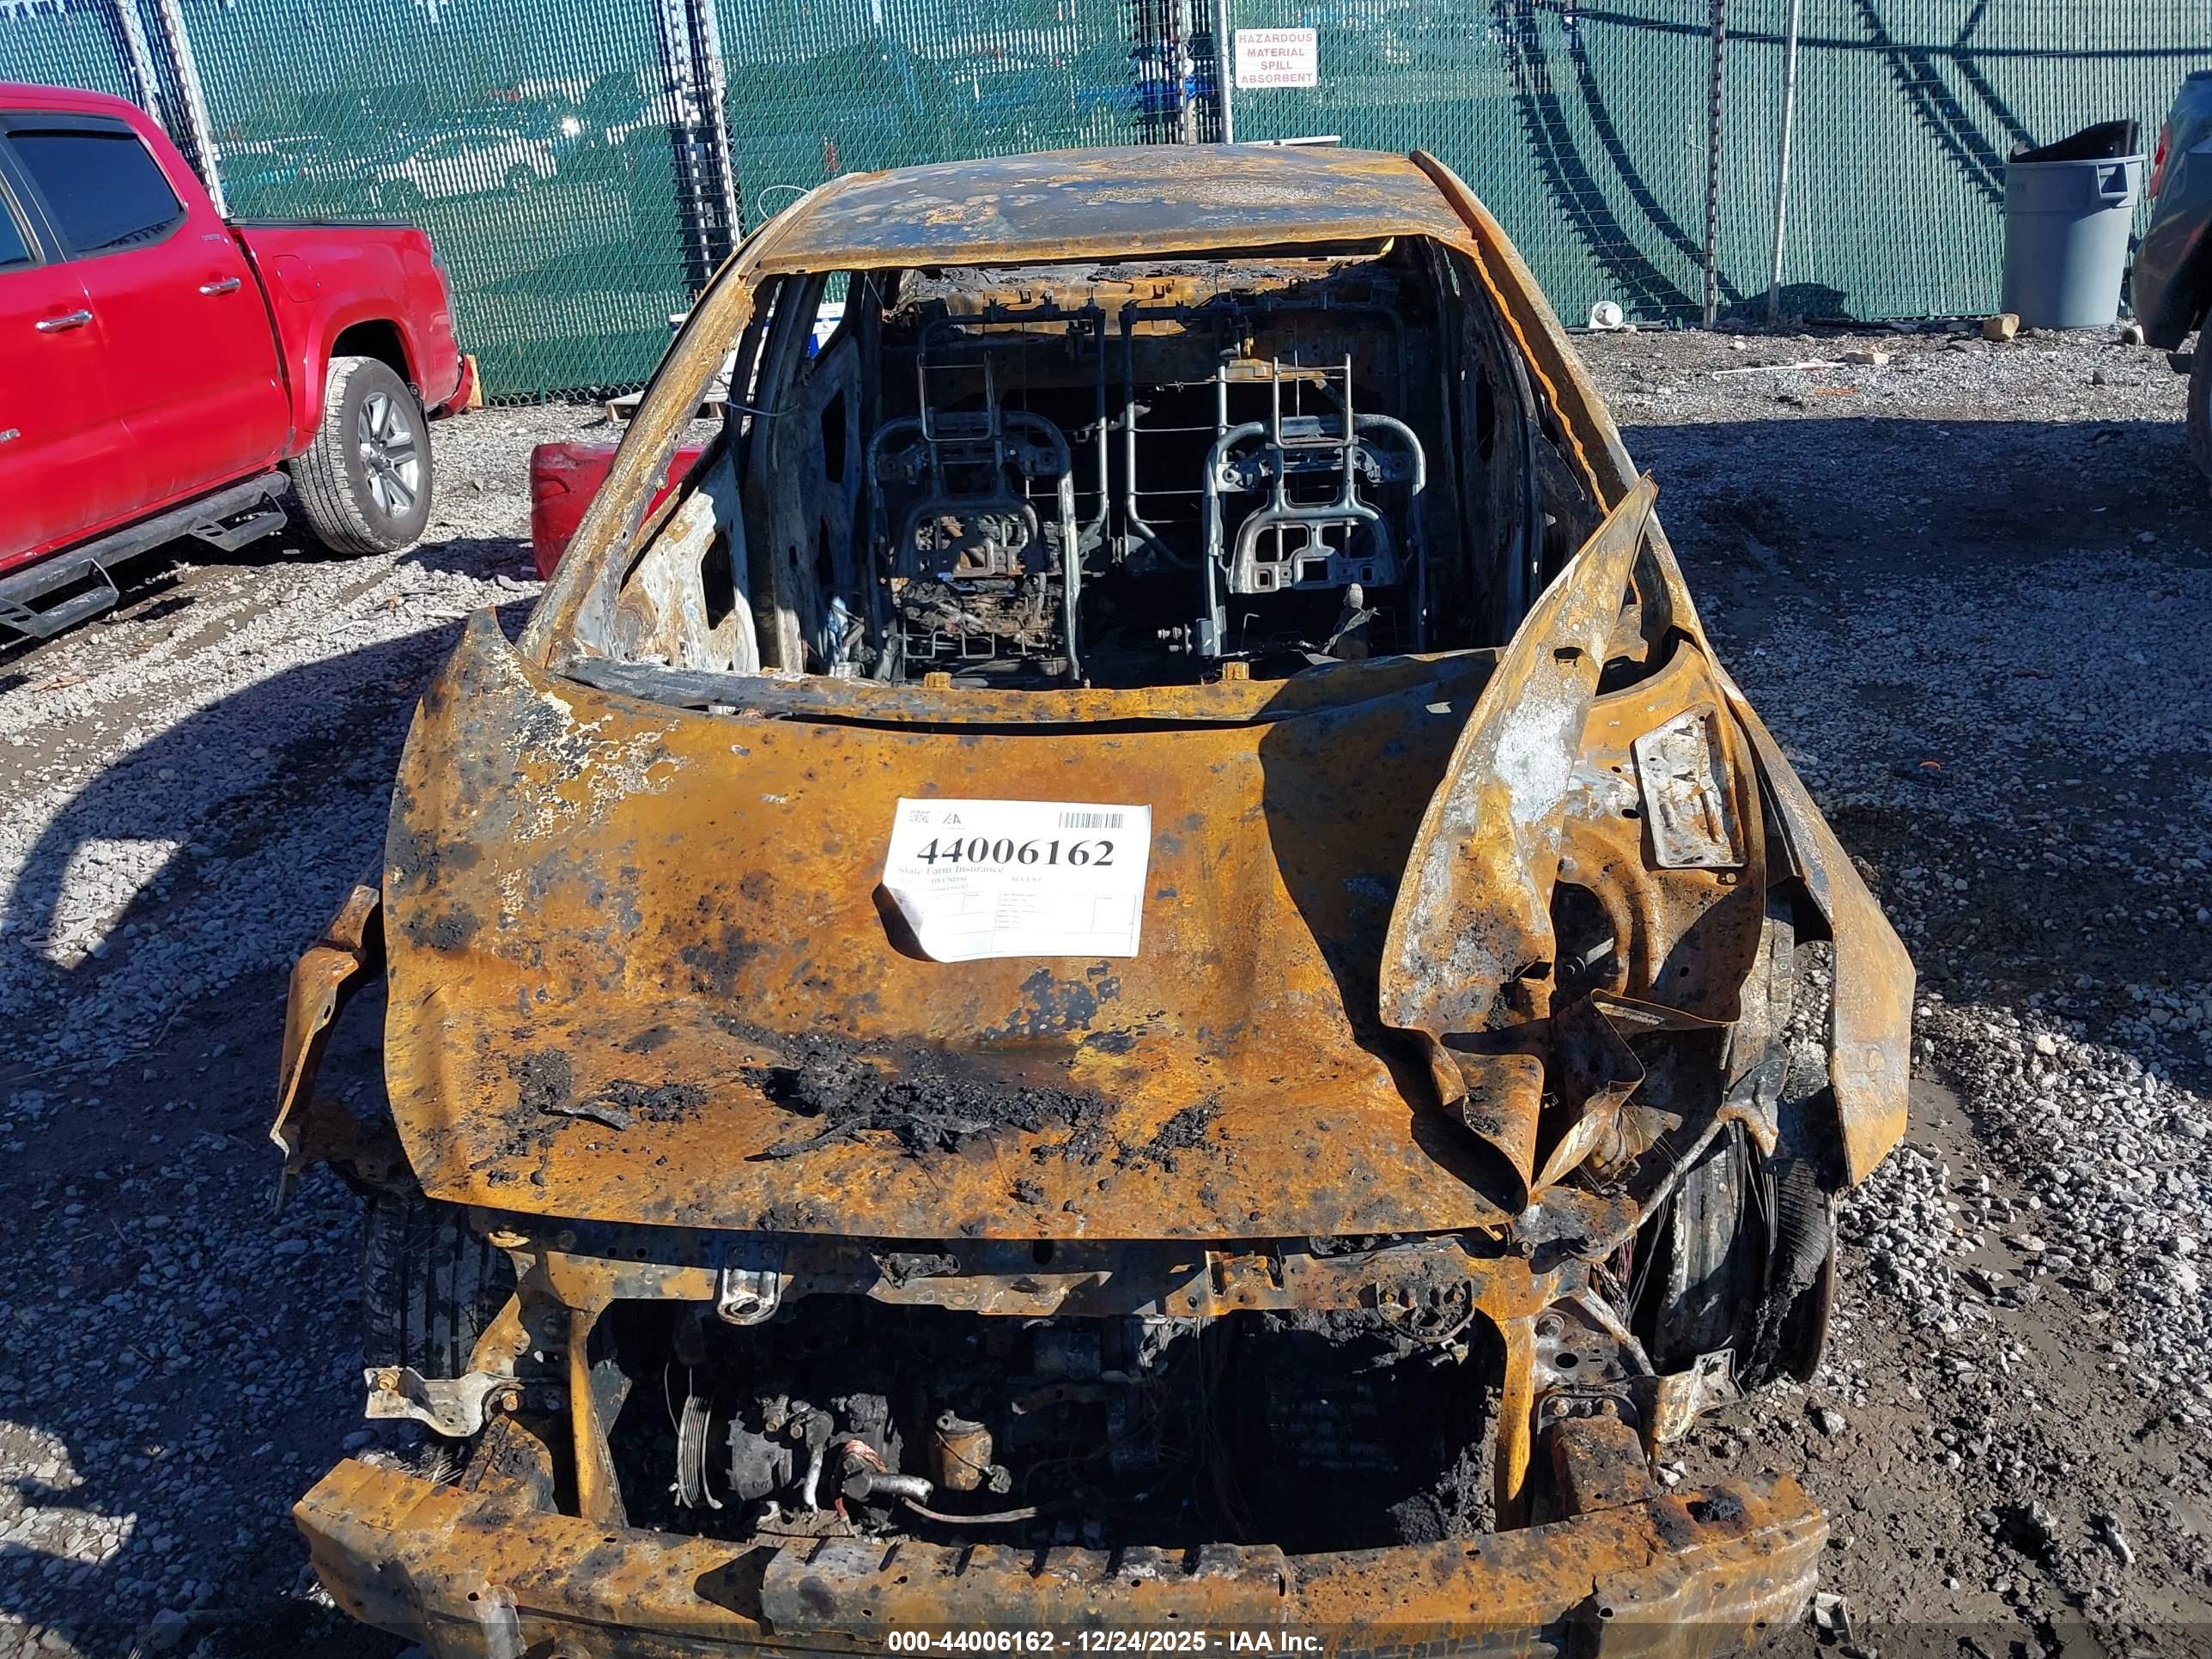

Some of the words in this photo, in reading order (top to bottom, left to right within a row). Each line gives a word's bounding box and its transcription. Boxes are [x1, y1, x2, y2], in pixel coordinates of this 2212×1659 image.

[1238, 33, 1313, 44] HAZARDOUS
[1247, 47, 1305, 58] MATERIAL
[1261, 61, 1292, 70] SPILL
[1241, 73, 1313, 84] ABSORBENT
[916, 836, 1115, 866] 44006162
[898, 866, 923, 876] State
[927, 866, 951, 875] Farm
[955, 865, 1004, 873] Insurance
